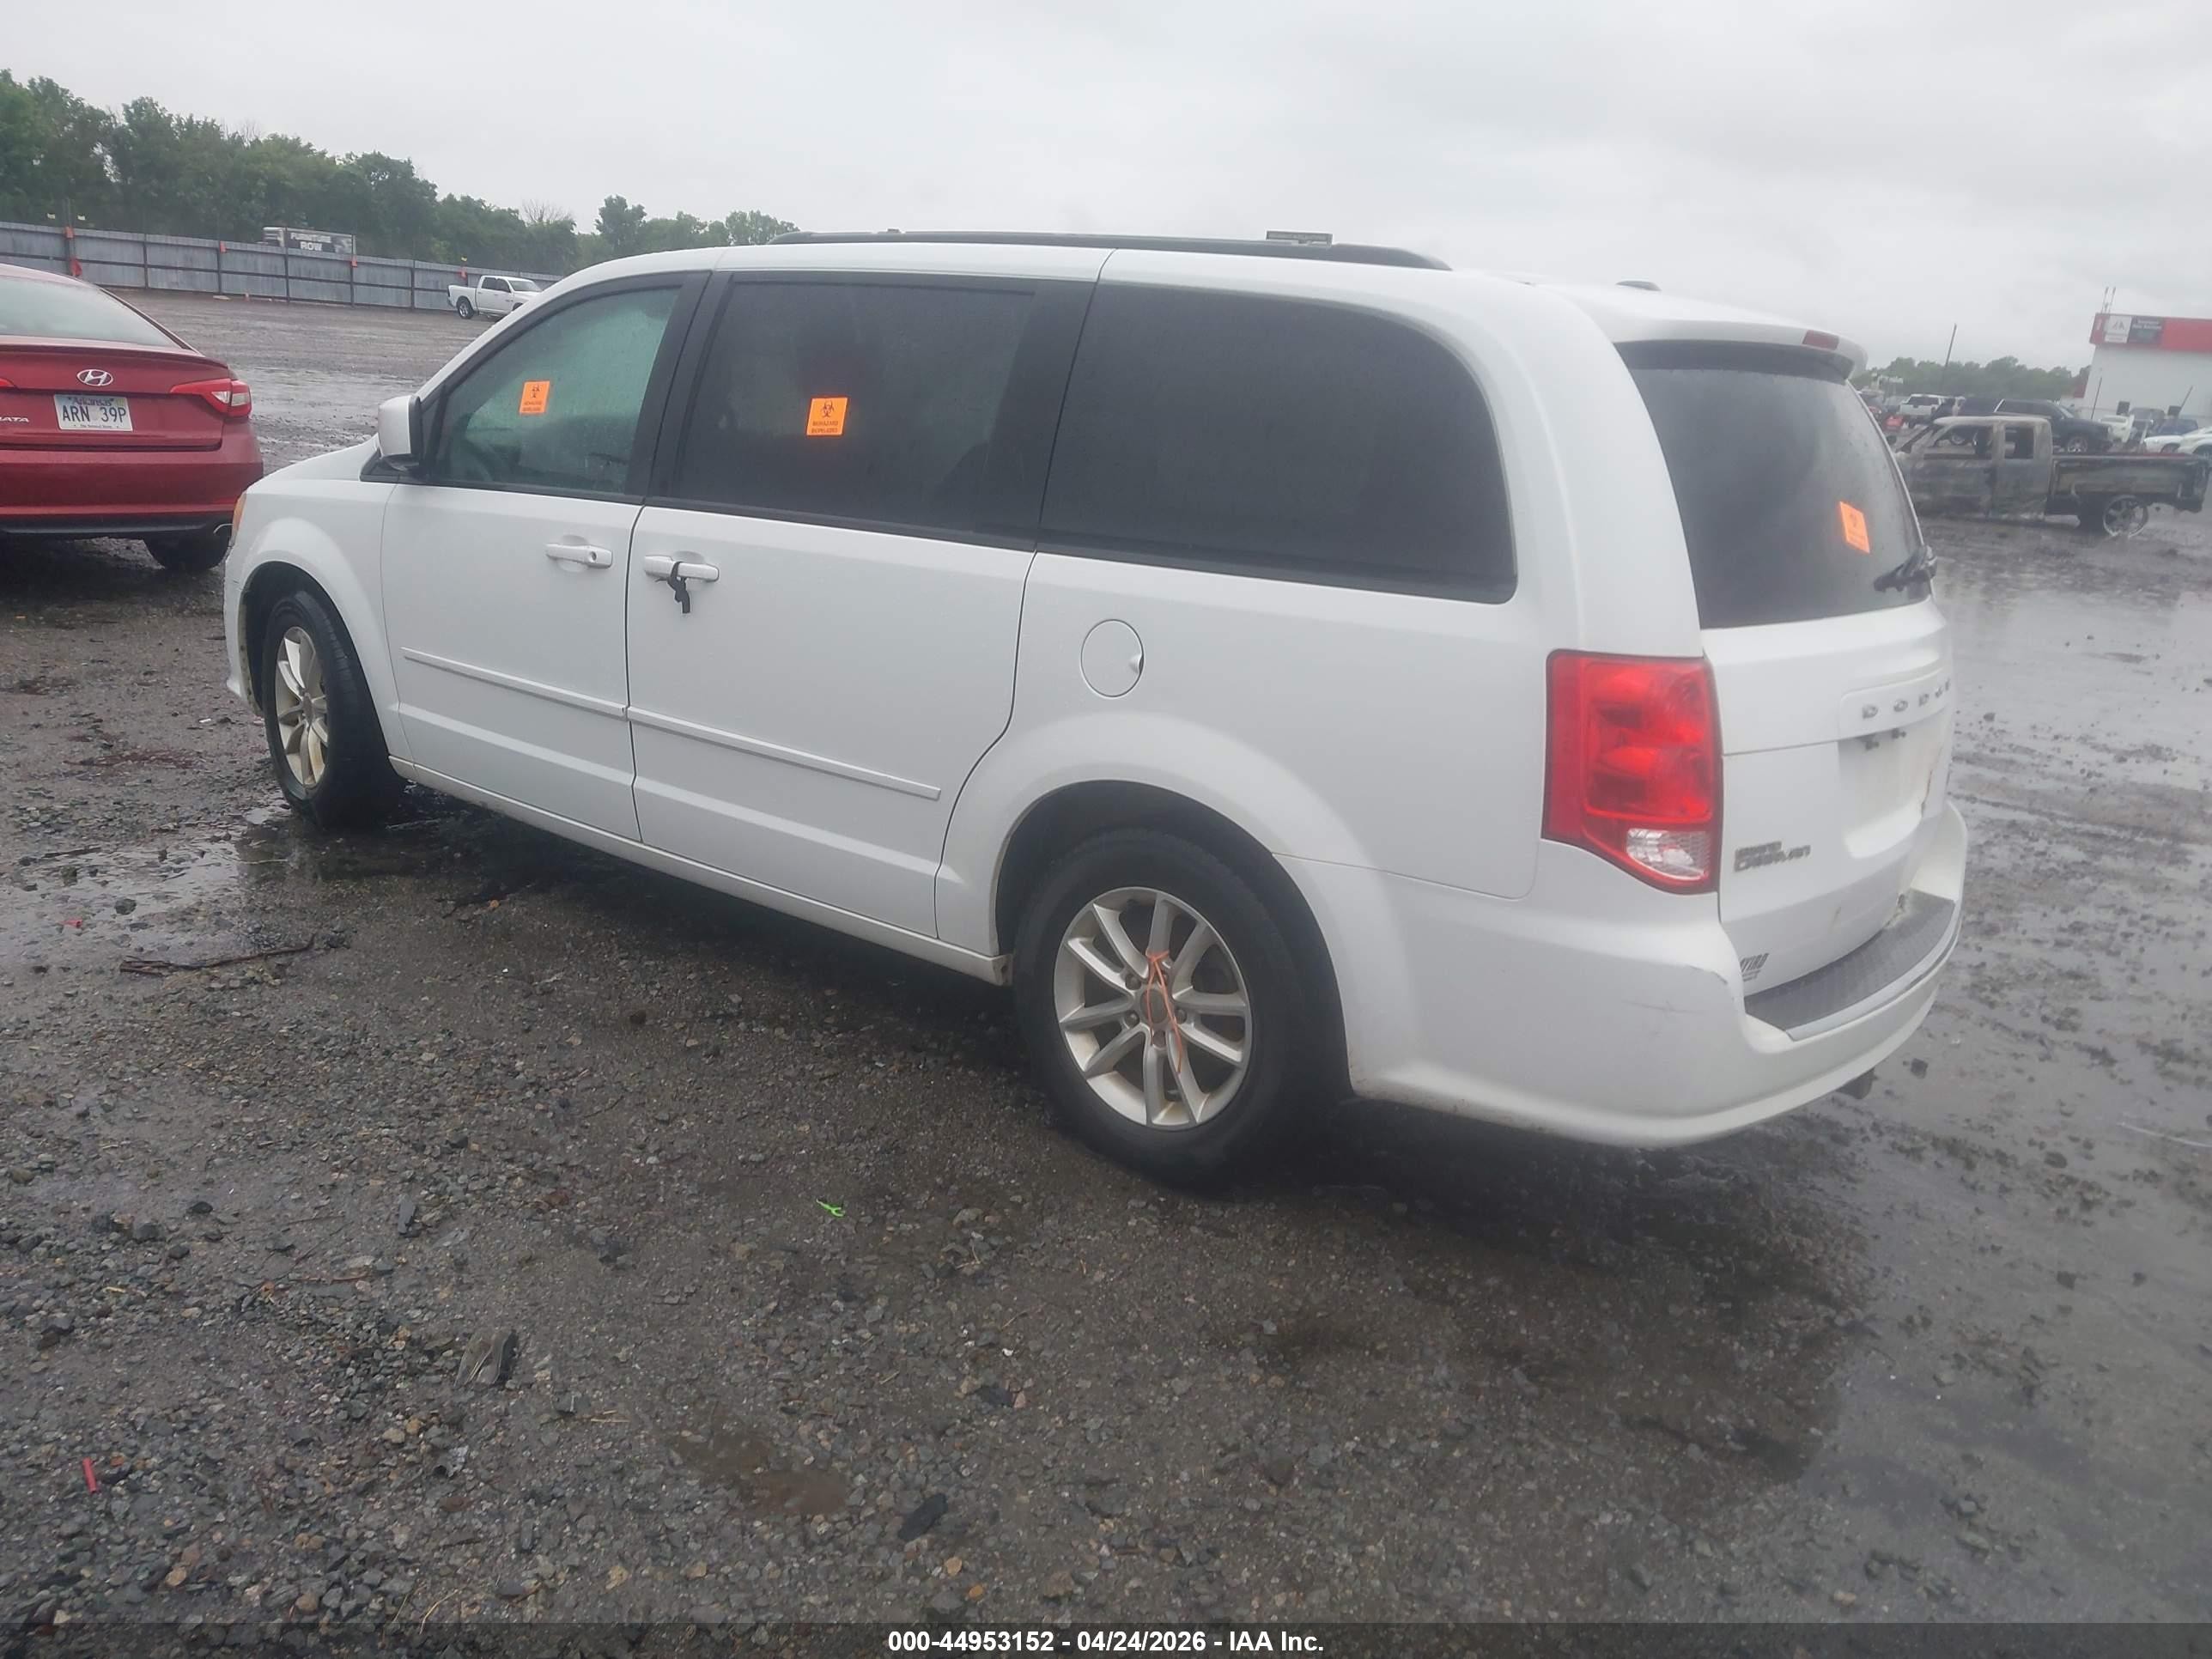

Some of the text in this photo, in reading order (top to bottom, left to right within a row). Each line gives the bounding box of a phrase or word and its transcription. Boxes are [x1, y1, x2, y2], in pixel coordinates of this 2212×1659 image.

[300, 241, 323, 252] ROW
[63, 405, 126, 423] ARN 39P
